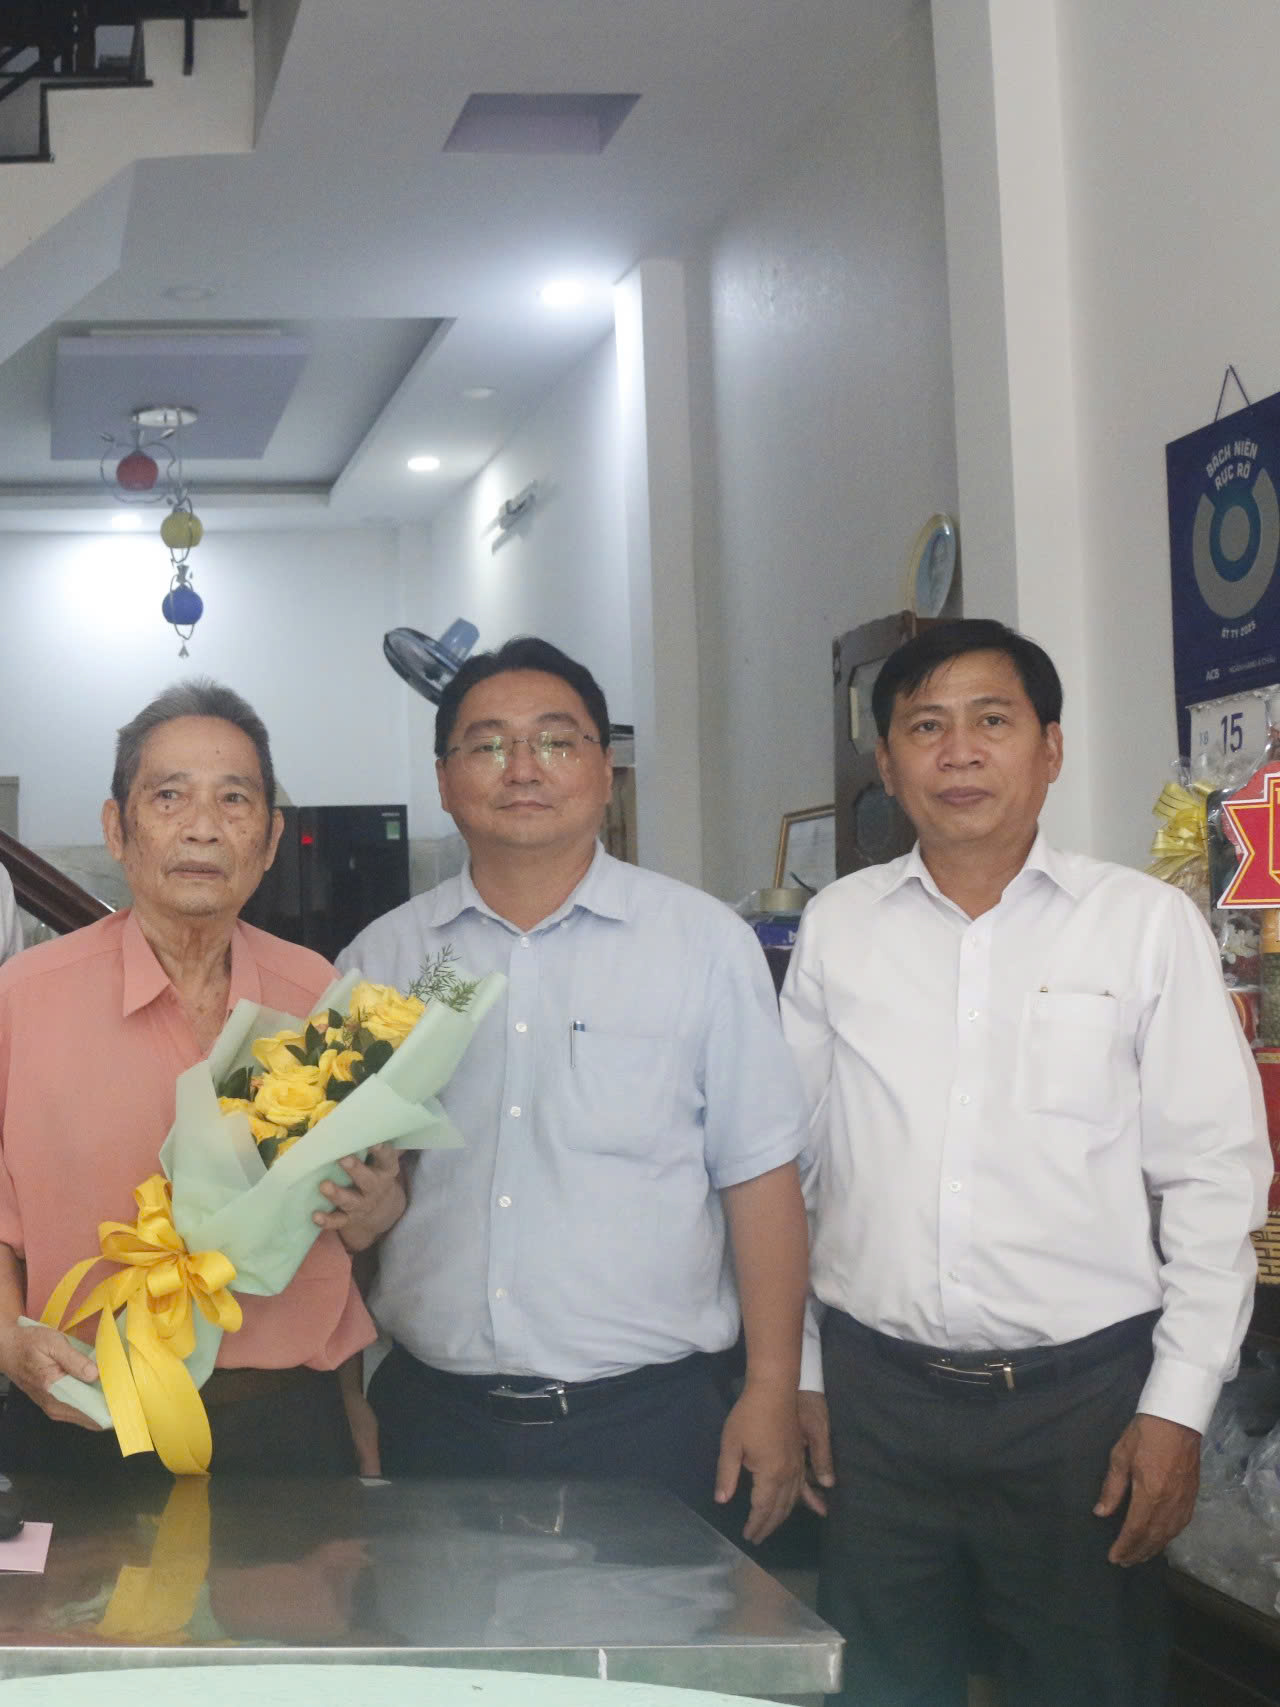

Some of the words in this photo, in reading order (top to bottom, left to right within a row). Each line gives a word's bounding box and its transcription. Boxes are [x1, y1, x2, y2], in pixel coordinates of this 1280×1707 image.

[1207, 443, 1231, 478] BÁCH
[1234, 438, 1258, 460] NIÊN
[1206, 668, 1220, 681] ACB
[1221, 712, 1243, 755] 15
